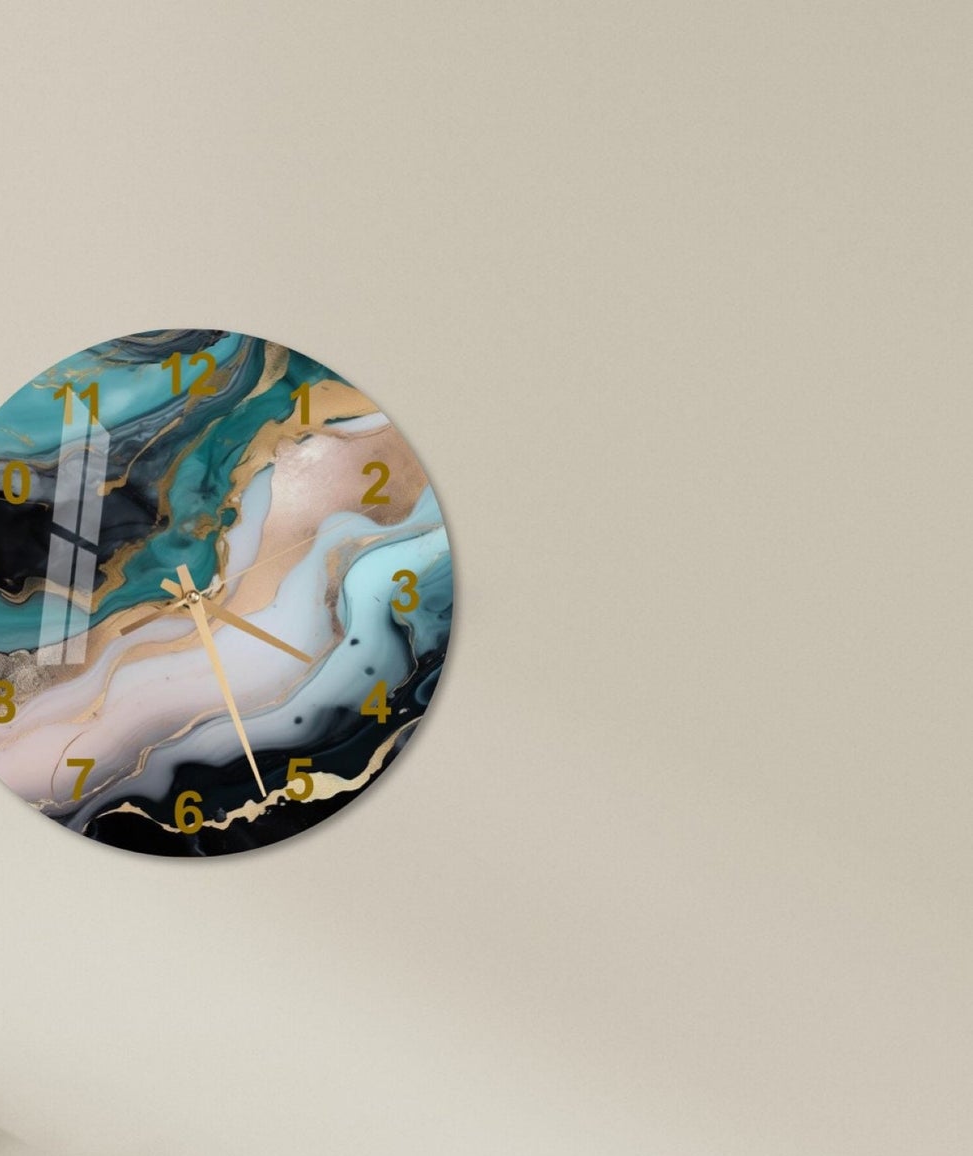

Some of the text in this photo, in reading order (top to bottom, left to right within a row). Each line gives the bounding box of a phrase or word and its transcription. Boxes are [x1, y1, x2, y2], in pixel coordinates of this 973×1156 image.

[162, 352, 217, 395] 12
[53, 383, 100, 425] 11
[290, 383, 310, 425] 1
[361, 461, 390, 505] 2
[391, 570, 419, 613] 3
[360, 681, 392, 723] 4
[66, 758, 95, 800] 7
[285, 758, 314, 801] 5
[174, 790, 204, 834] 6
